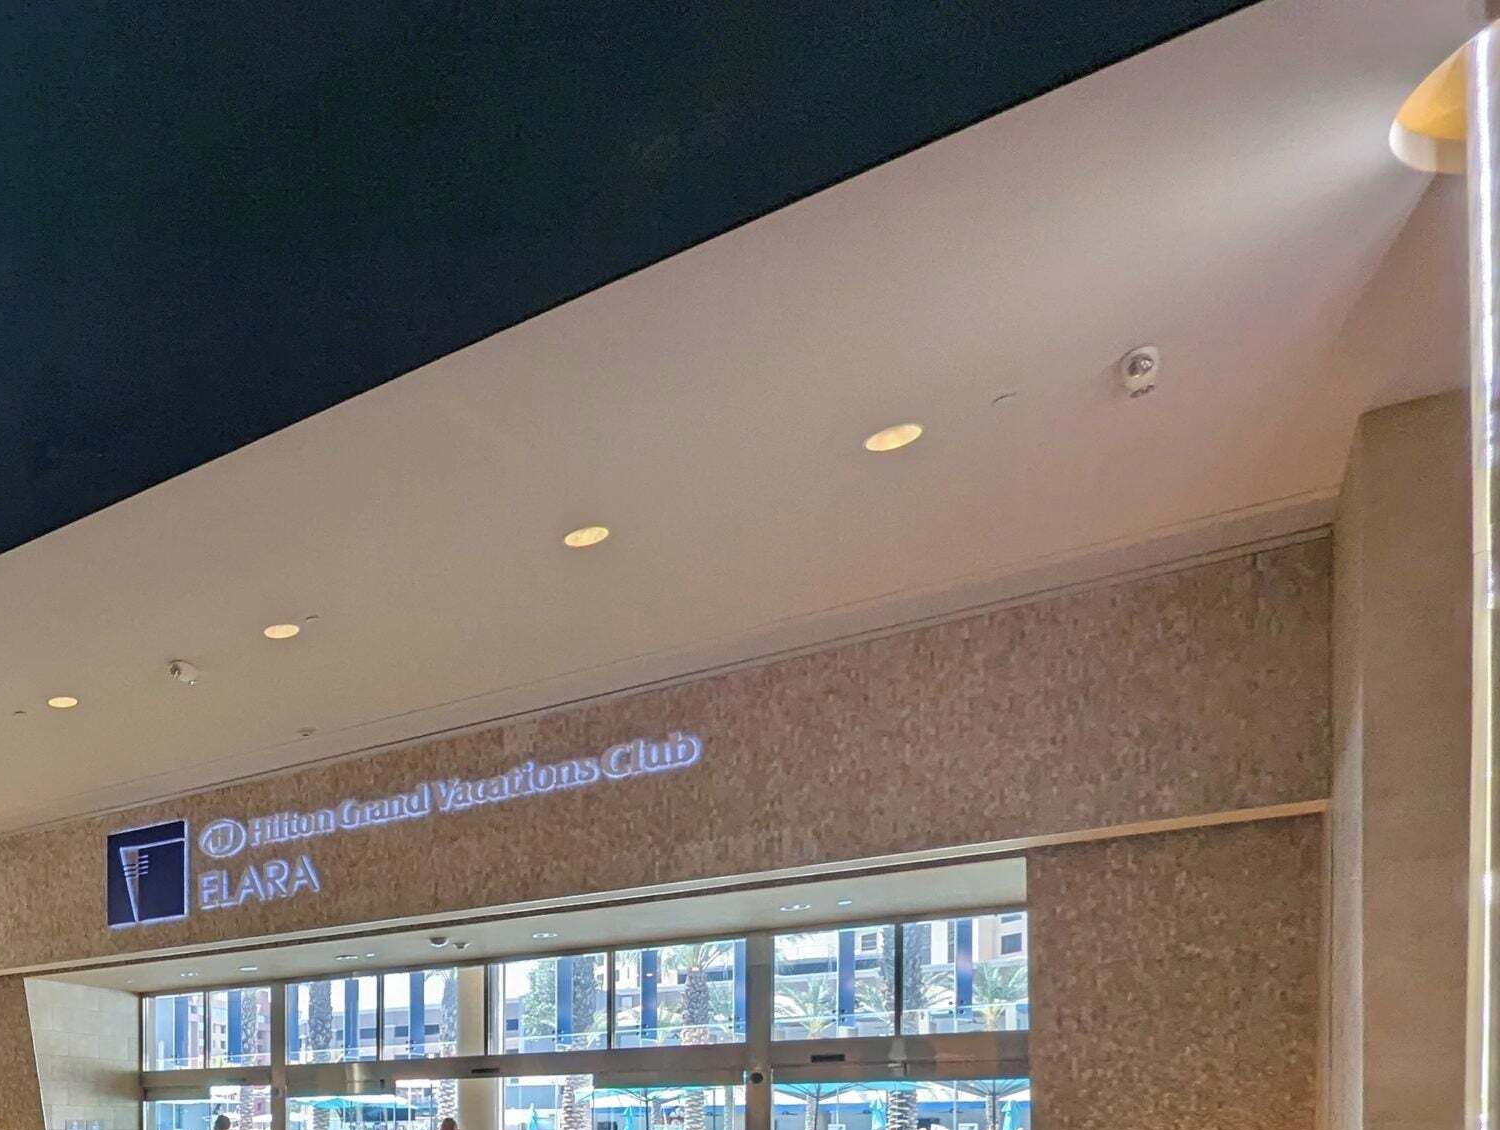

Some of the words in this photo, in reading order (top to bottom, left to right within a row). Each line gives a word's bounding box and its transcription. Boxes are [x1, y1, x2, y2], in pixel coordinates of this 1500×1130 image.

[249, 809, 335, 847] Hilton
[338, 782, 432, 830] Grand
[438, 758, 601, 813] Vacations
[601, 732, 703, 780] Club
[200, 854, 321, 910] ELARA
